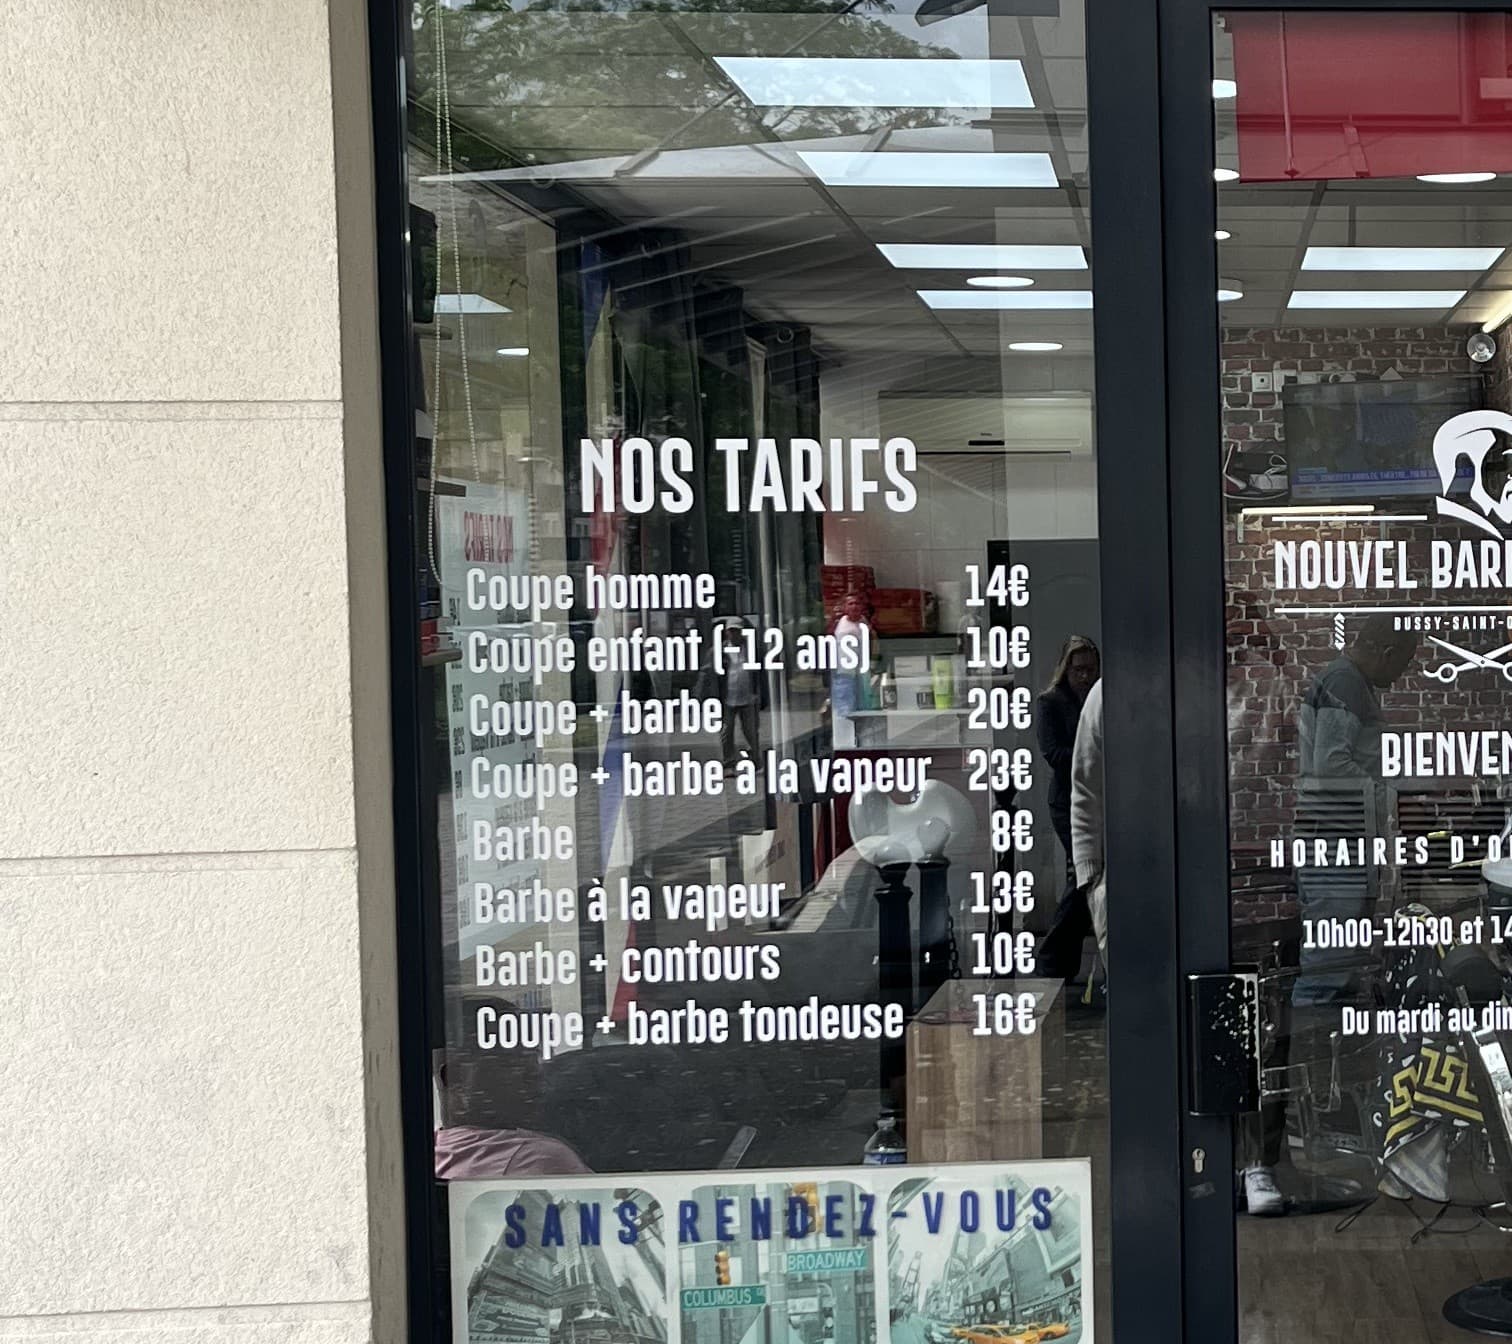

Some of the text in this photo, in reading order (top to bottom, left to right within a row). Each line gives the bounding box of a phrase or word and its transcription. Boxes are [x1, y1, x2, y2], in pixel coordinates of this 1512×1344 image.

[580, 436, 917, 514] NOS TARIFS
[1274, 538, 1418, 591] NOUVEL
[466, 564, 1030, 622] Coupe homme 14€
[467, 631, 576, 685] Coupe
[588, 627, 702, 673] enfant
[713, 628, 785, 674] (-12
[796, 623, 870, 673] ans)
[966, 626, 1031, 670] 10€
[468, 694, 577, 748] Coupe
[589, 705, 609, 724] +
[621, 689, 723, 735] barbe
[967, 687, 1032, 731] 20€
[470, 756, 579, 810] Coupe
[591, 766, 611, 786] +
[624, 751, 725, 798] barbe
[737, 751, 757, 795] à
[767, 751, 799, 794] la
[811, 755, 932, 807] vapeur
[968, 748, 1033, 793] 23€
[473, 817, 573, 862] Barbe
[991, 809, 1035, 854] 8€
[1271, 836, 1429, 869] HORAIRES
[474, 880, 575, 924] Barbe
[587, 878, 608, 922] à
[618, 877, 651, 921] la
[663, 880, 786, 932] vapeur
[970, 871, 1035, 915] 13€
[476, 932, 1036, 987] Barbe + contours 10€
[1303, 918, 1454, 949] 10h00-12h30
[1459, 917, 1484, 946] et
[476, 993, 1037, 1059] Coupe + barbe tondeuse 16€
[1342, 1006, 1371, 1037] Du
[1374, 1004, 1443, 1036] mardi
[1447, 1009, 1476, 1034] au
[503, 1185, 1056, 1249] SANS RENDEZ-VOUS
[787, 1249, 866, 1271] BROADWAY
[683, 1287, 752, 1307] COLUMBUS
